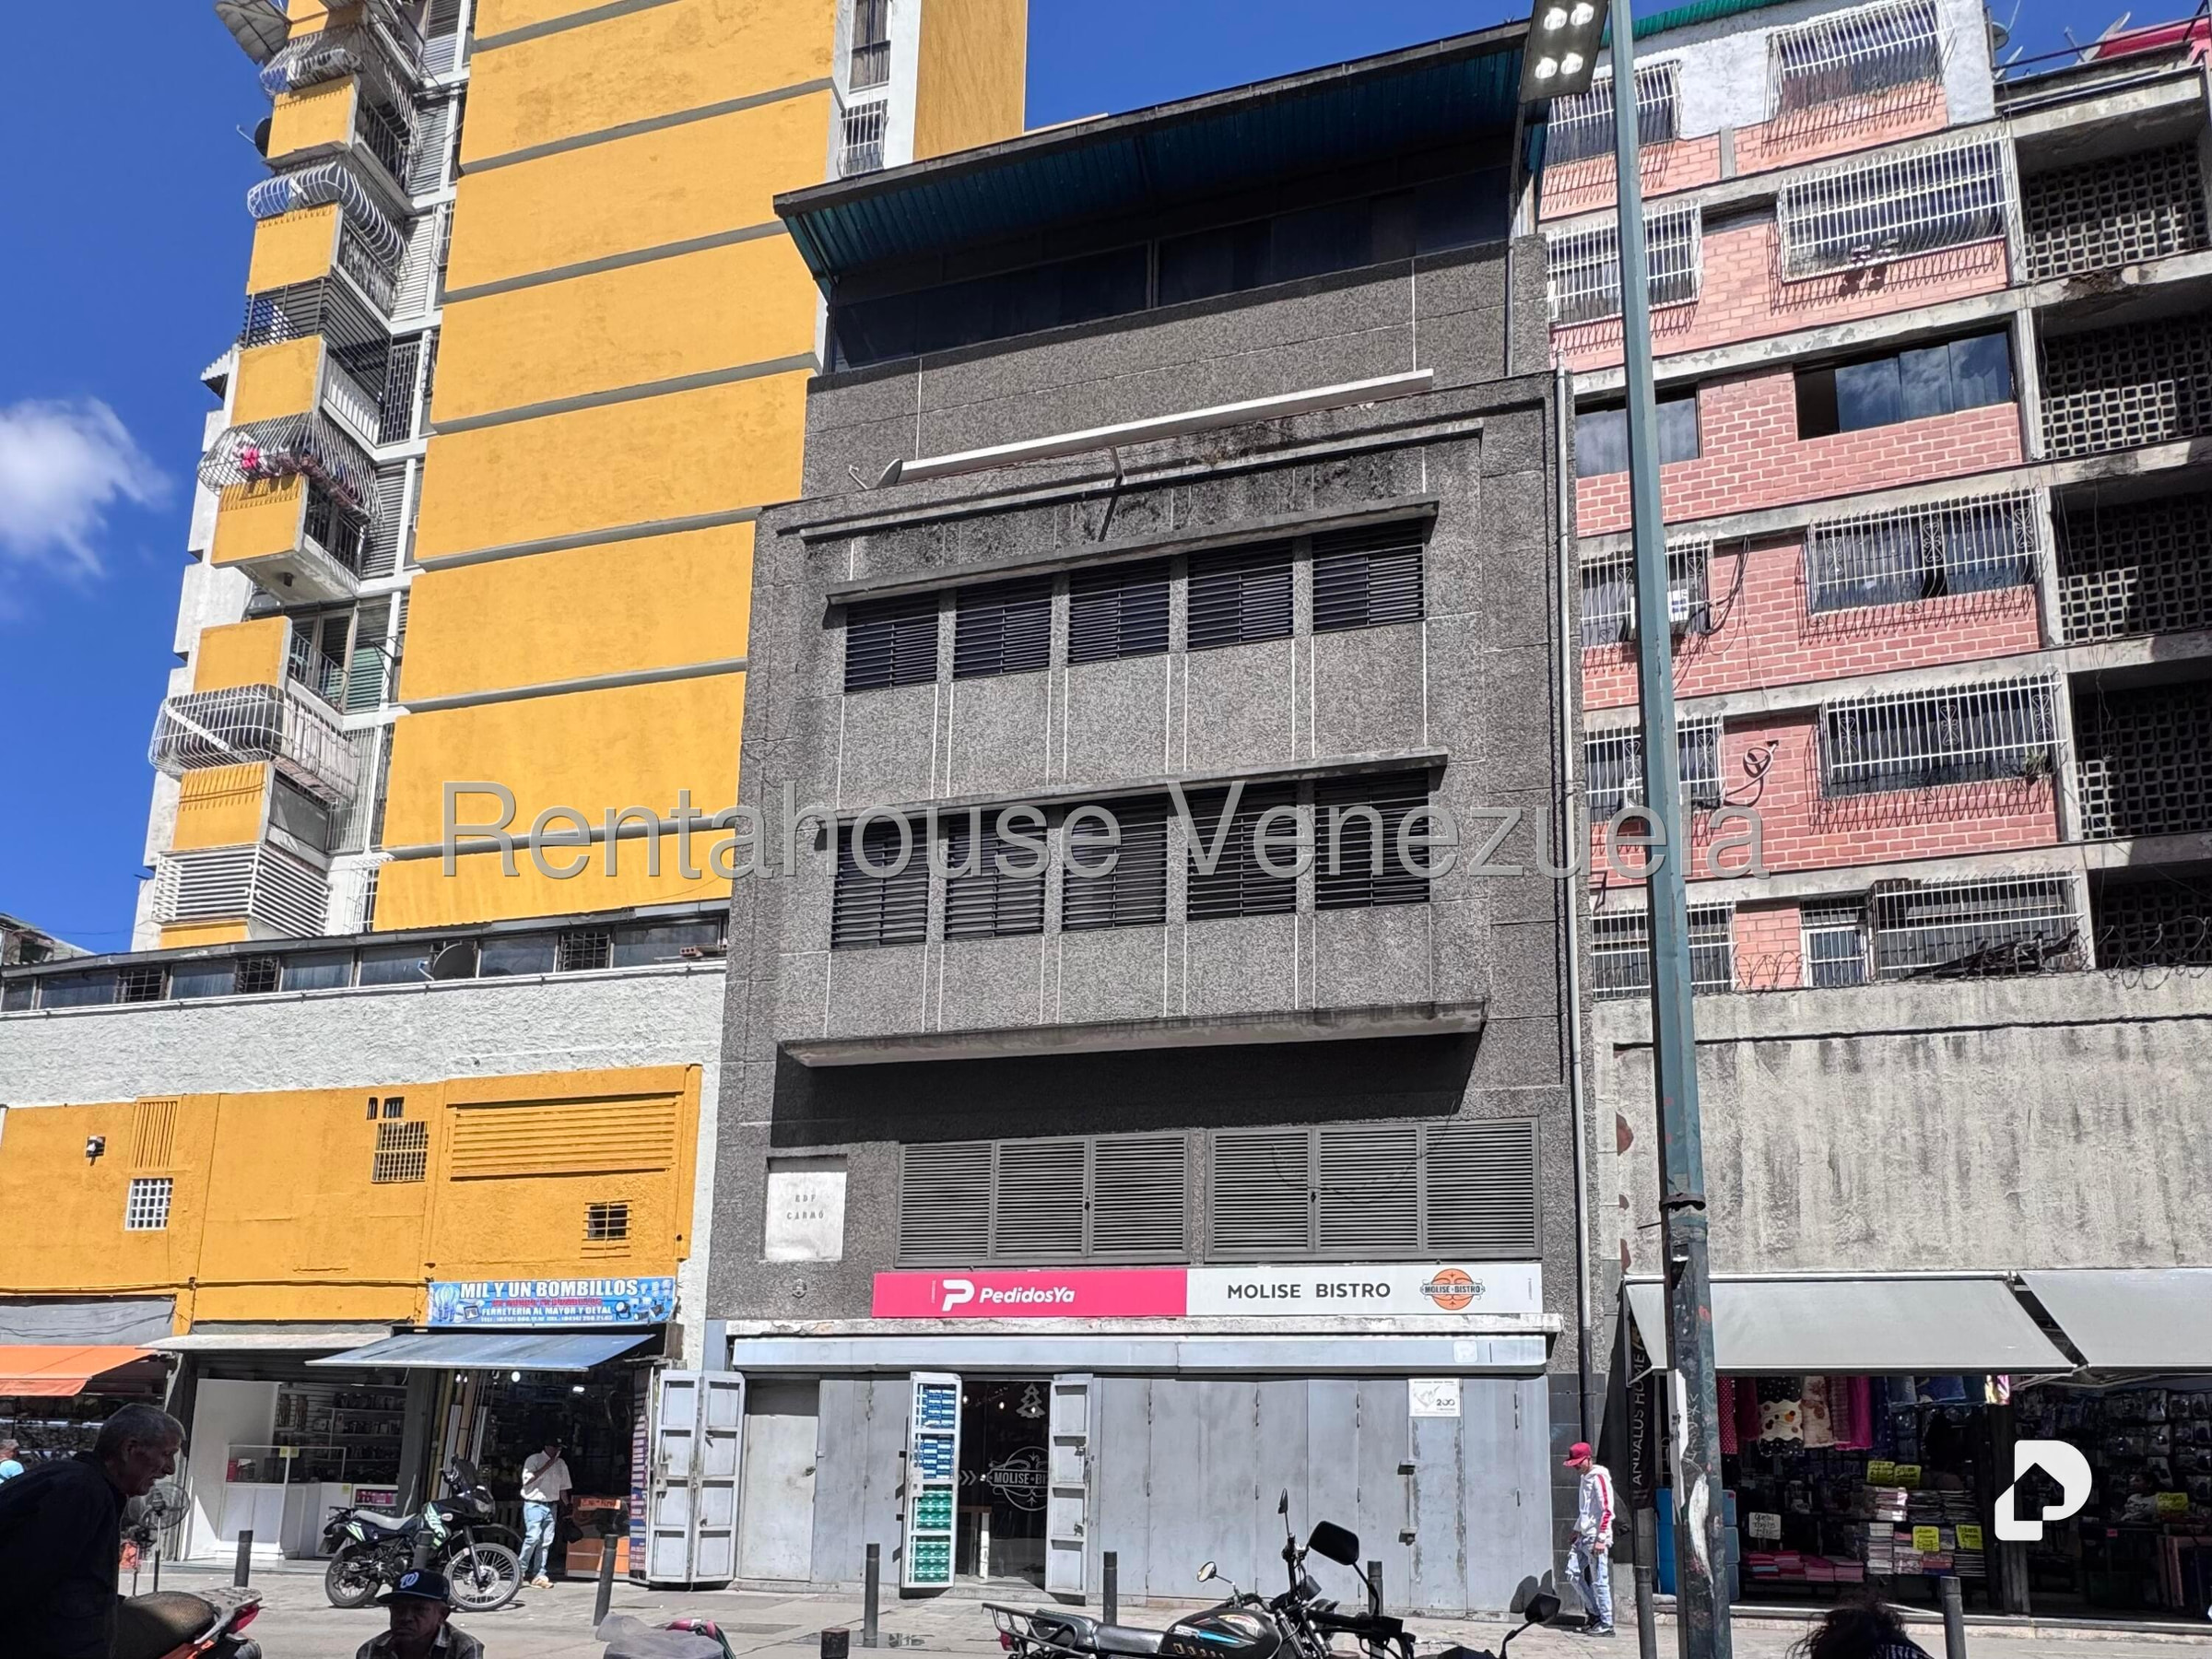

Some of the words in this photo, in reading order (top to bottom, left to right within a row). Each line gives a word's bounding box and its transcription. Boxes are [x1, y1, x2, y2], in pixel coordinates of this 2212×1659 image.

[460, 1282, 490, 1299] MIL
[494, 1282, 505, 1298] Y
[508, 1281, 532, 1298] UN
[535, 1279, 638, 1297] BOMBILLOS
[979, 1287, 1076, 1303] PedidosYa
[1227, 1284, 1301, 1299] MOLISE
[1315, 1282, 1391, 1299] BISTRO
[1424, 1285, 1451, 1293] MOLISE
[1453, 1285, 1481, 1293] BISTRO
[533, 1307, 543, 1315] AL
[545, 1307, 576, 1315] MAYOR
[585, 1306, 612, 1314] DETAL
[1633, 1354, 1645, 1405] HOME
[1631, 1409, 1645, 1486] ANDALUS
[994, 1472, 1030, 1485] MOLISE
